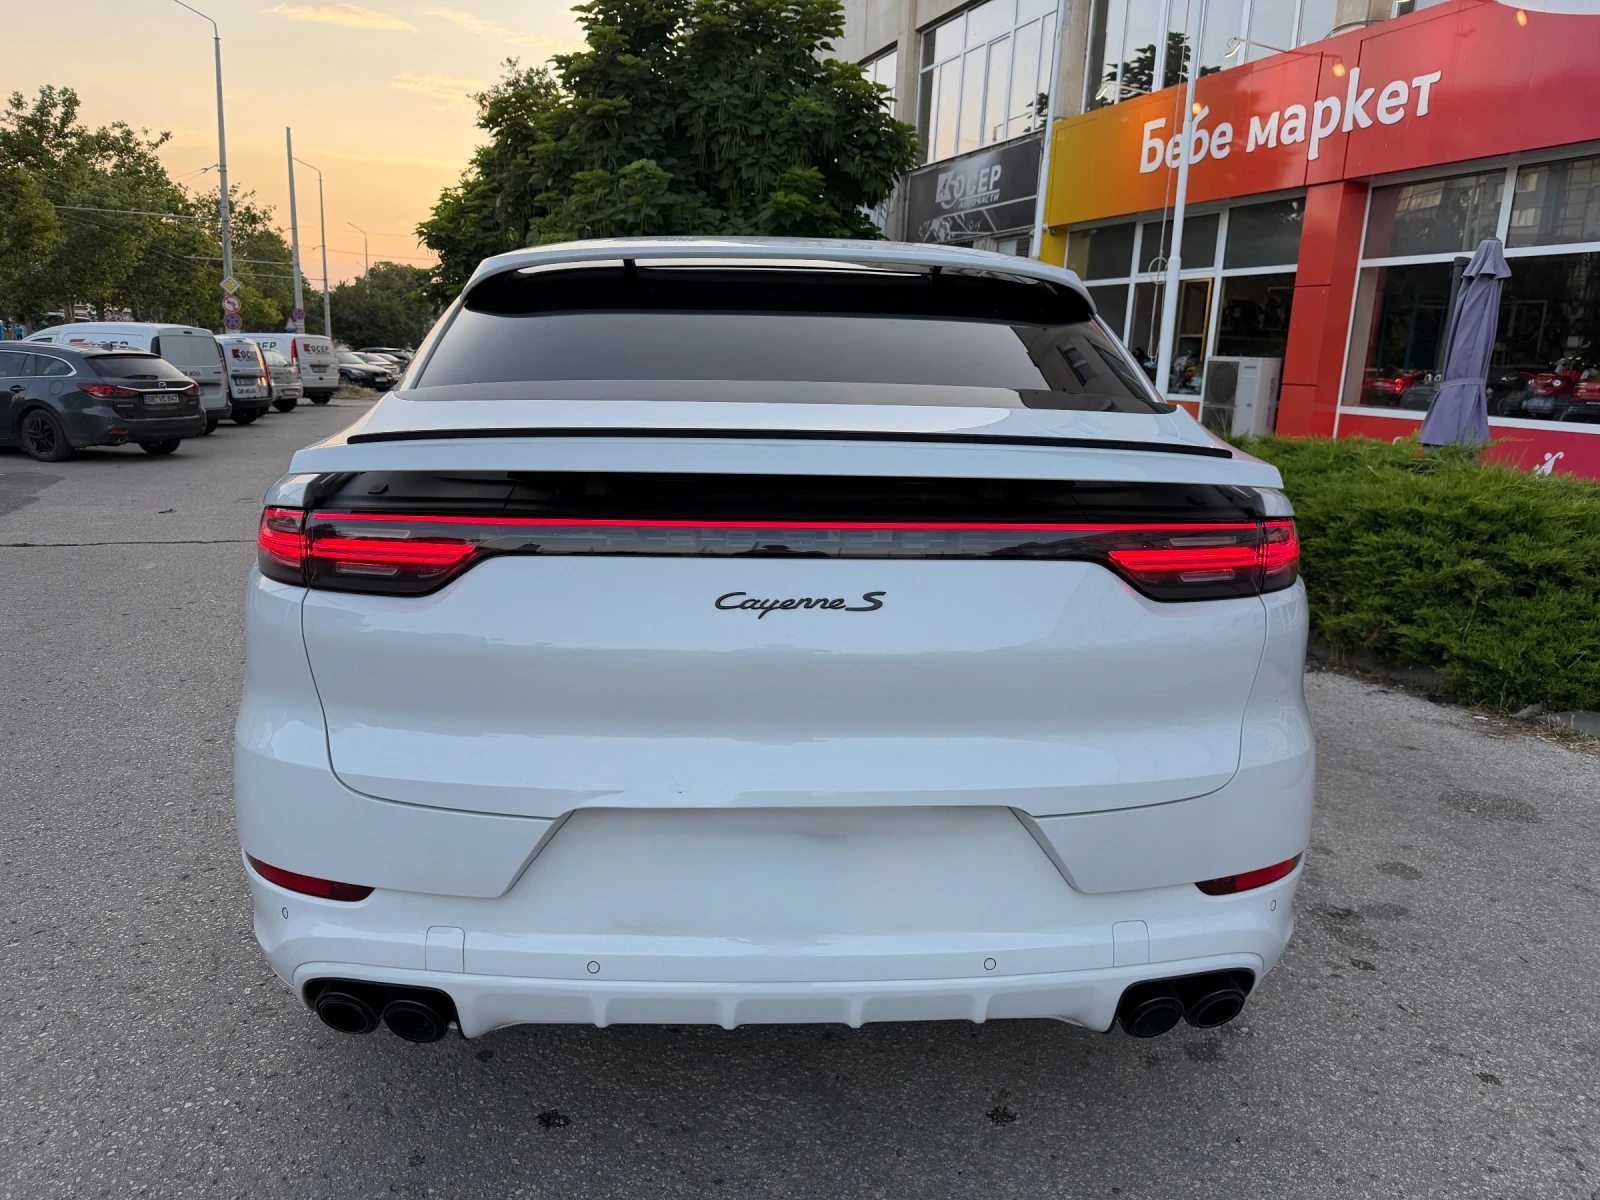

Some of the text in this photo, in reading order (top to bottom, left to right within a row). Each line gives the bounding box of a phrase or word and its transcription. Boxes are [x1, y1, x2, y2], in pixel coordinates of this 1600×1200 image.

[1139, 67, 1442, 173] Бебе маркет
[714, 591, 887, 620] Cayenne S
